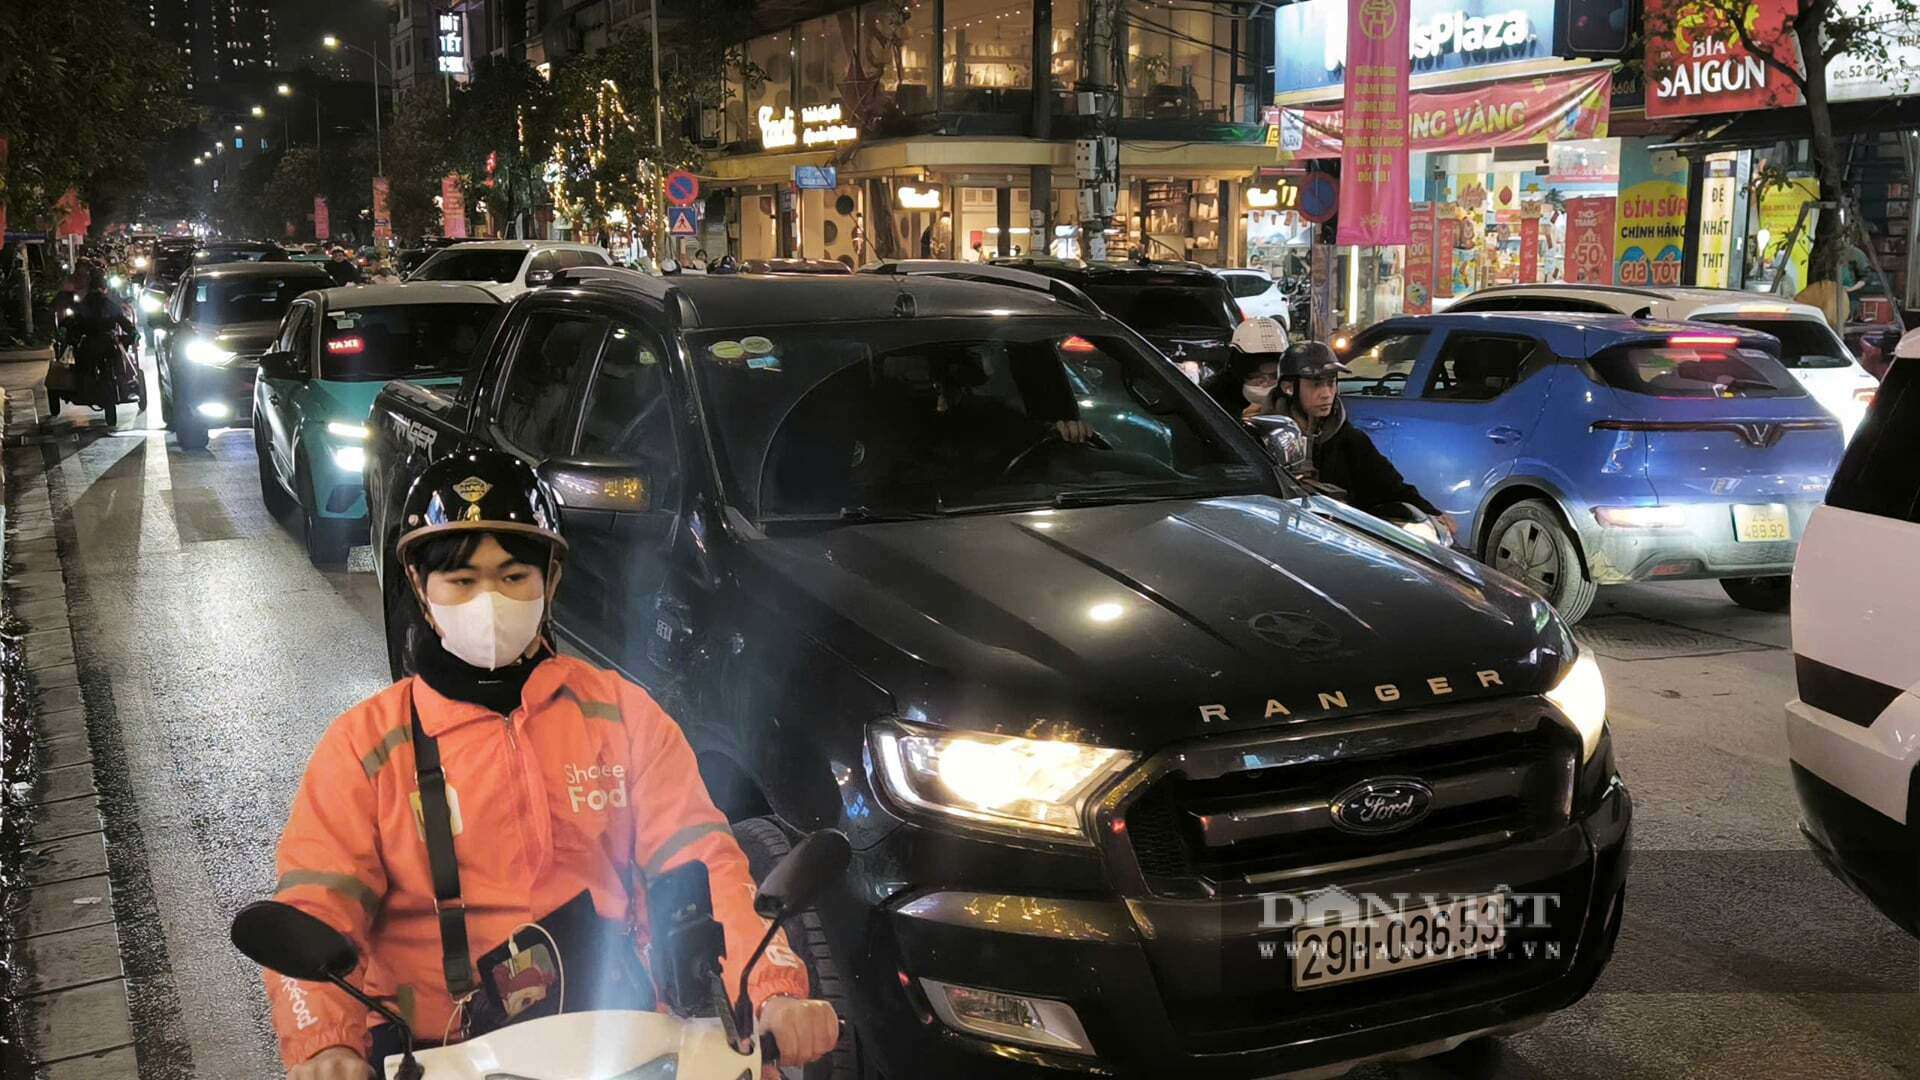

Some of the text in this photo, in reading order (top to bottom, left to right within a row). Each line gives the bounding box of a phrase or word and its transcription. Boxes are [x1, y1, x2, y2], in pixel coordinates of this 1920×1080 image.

[1692, 36, 1726, 58] BIA
[1849, 65, 1863, 78] 52
[1454, 100, 1527, 136] VÀNG
[1621, 226, 1655, 239] CHÍNH
[1702, 215, 1729, 236] NHẤT
[1577, 245, 1602, 266] 50
[1702, 252, 1725, 272] THỊT
[1651, 251, 1681, 283] TỐT
[1199, 669, 1504, 723] RANGER
[1360, 793, 1414, 821] Ford
[1301, 897, 1500, 981] 29H-036.53
